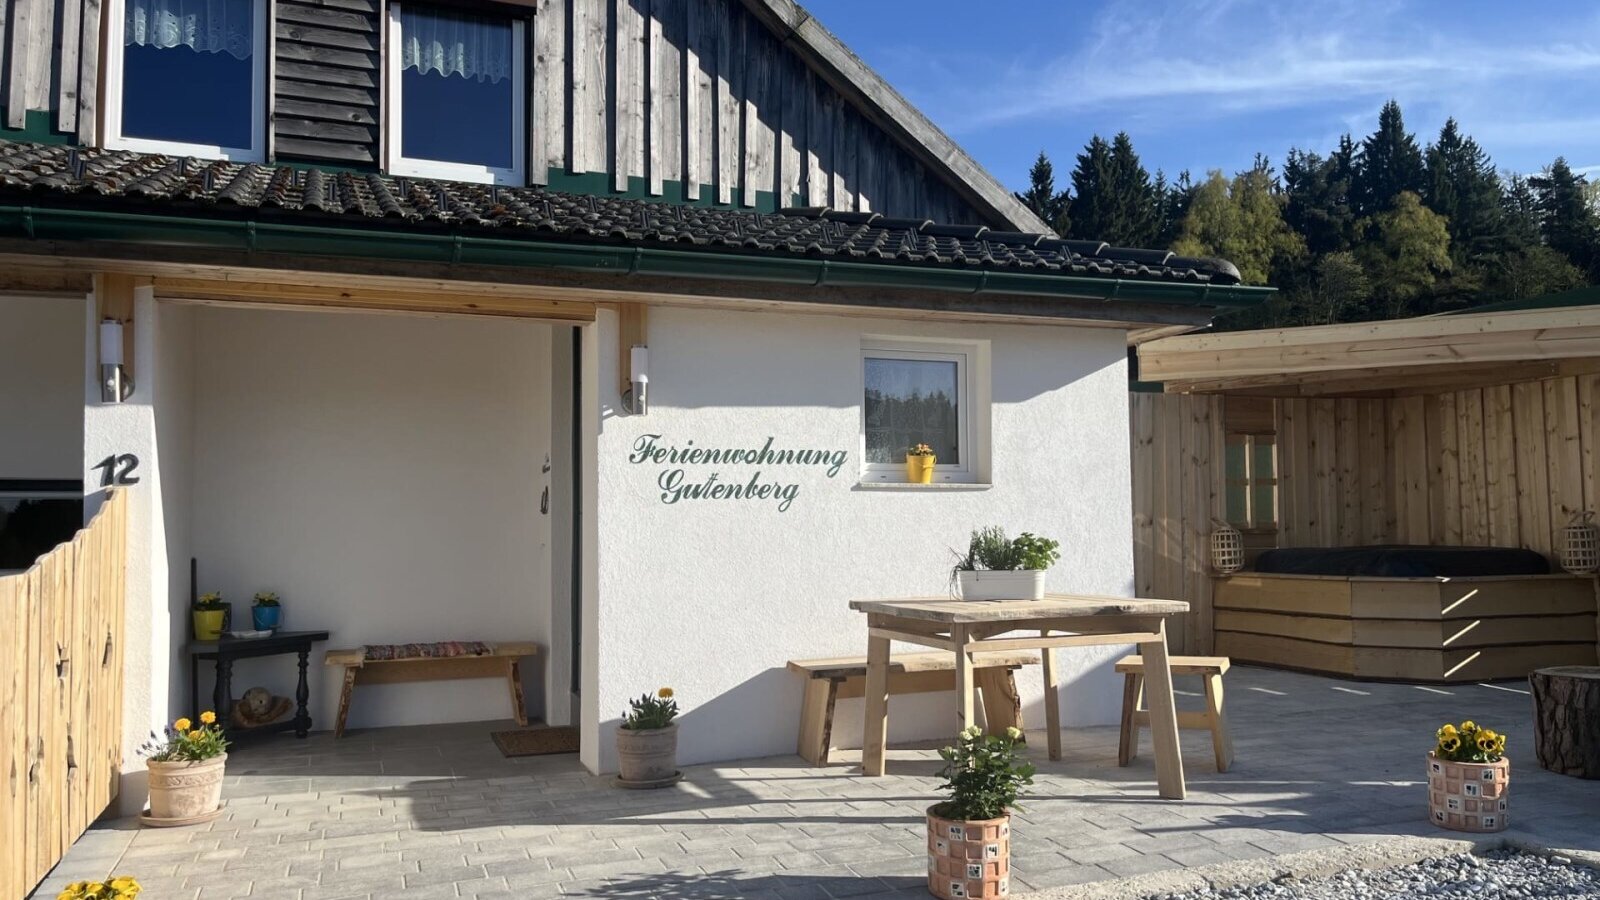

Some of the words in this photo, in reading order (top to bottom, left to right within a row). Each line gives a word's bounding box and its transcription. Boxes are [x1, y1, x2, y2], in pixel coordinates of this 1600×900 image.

[90, 453, 140, 487] 12
[629, 433, 848, 478] Ferienwohnung
[658, 469, 800, 513] Gutenberg
